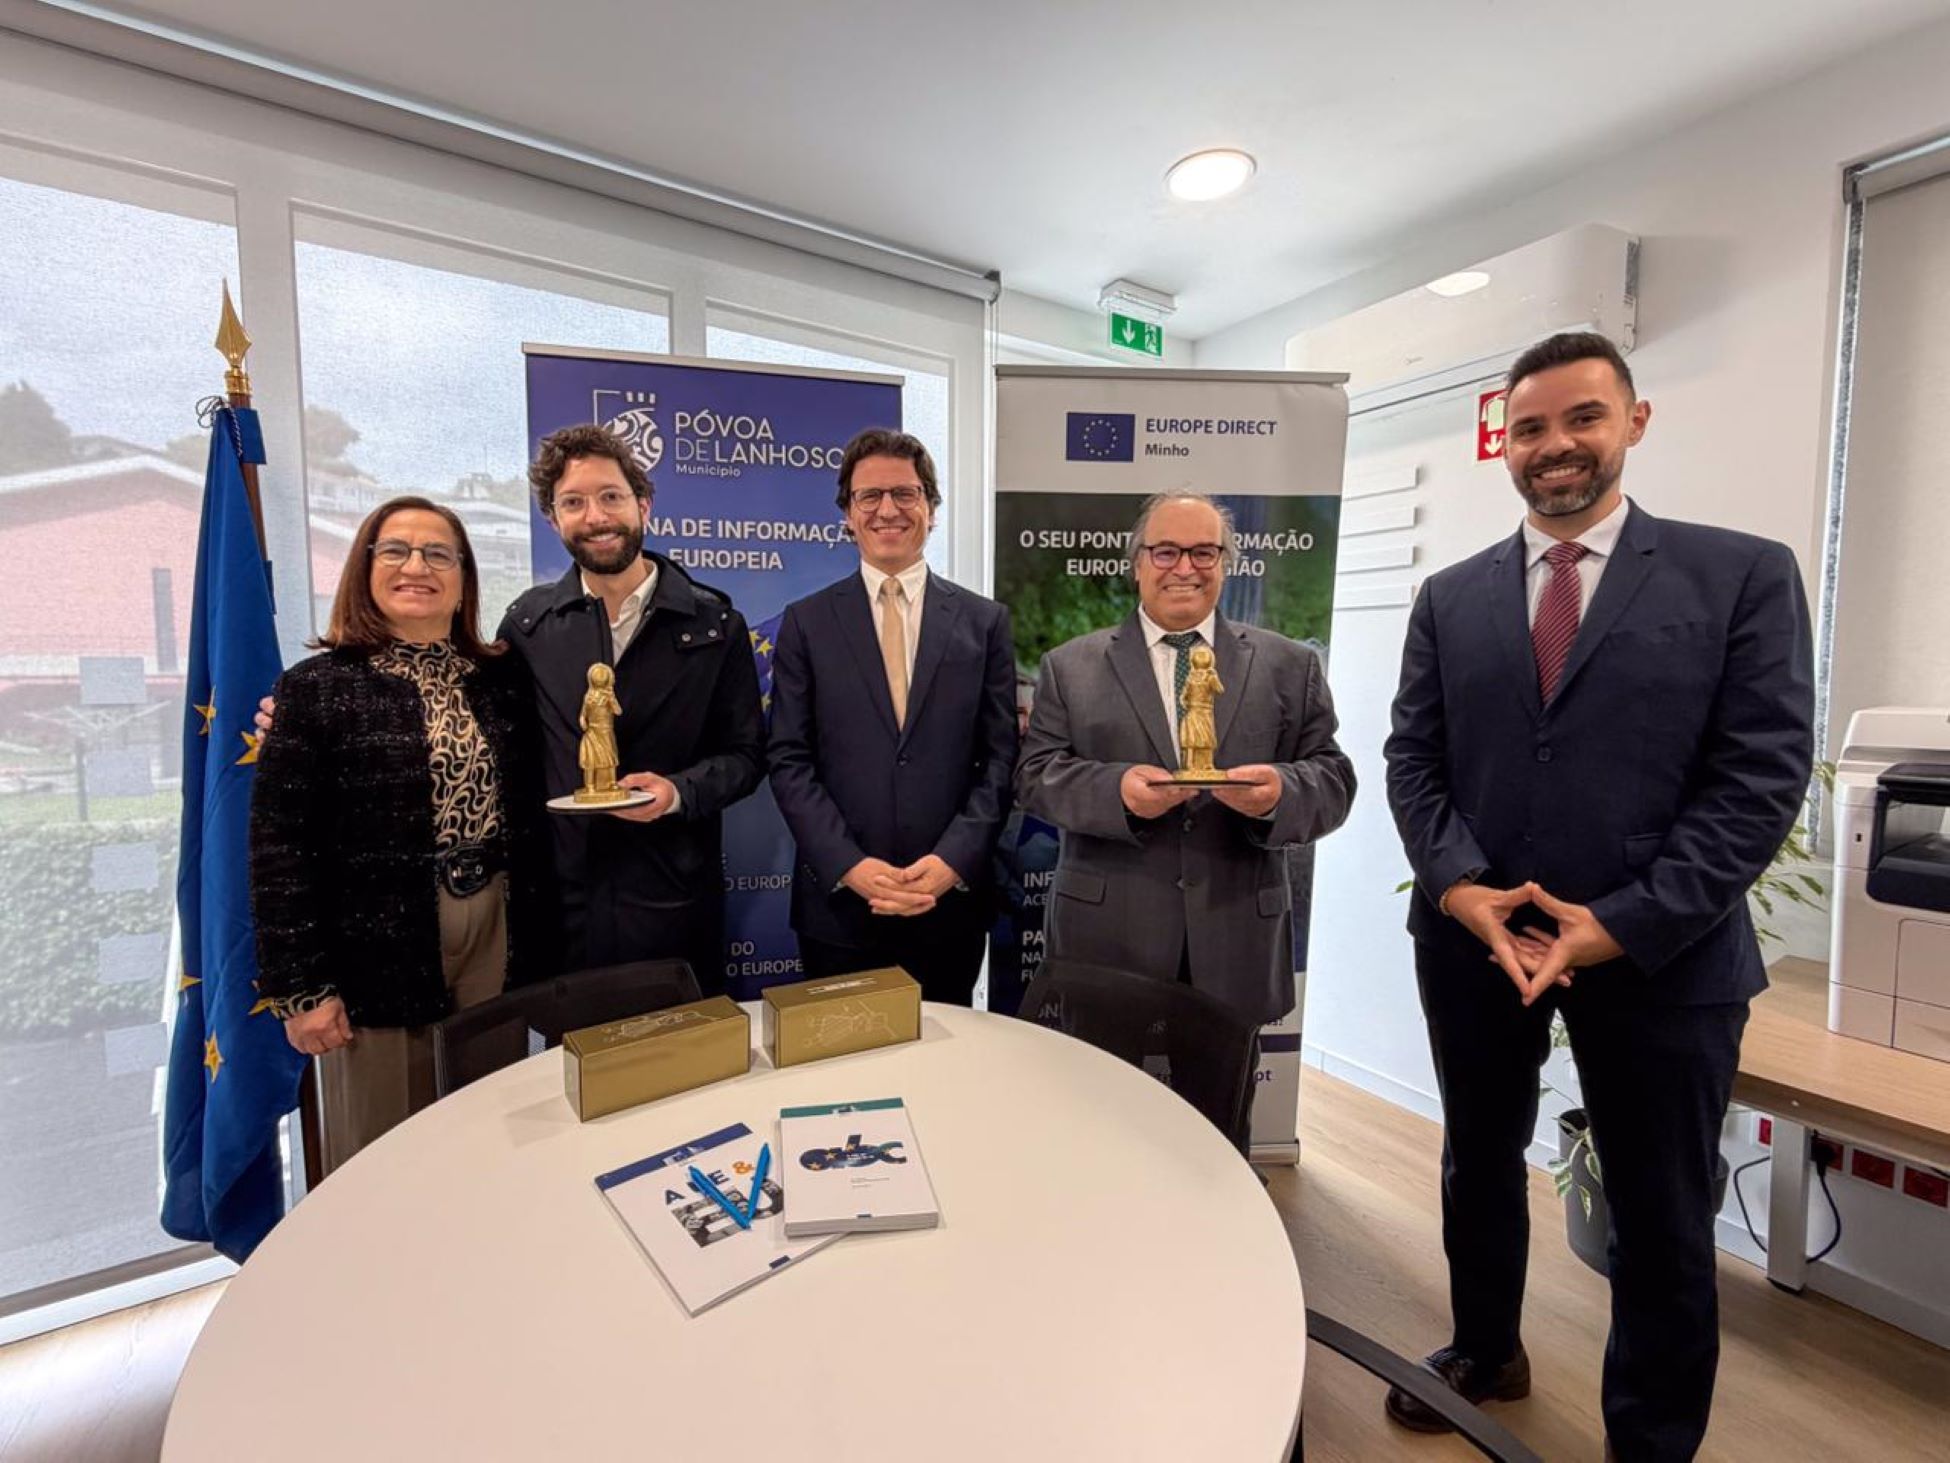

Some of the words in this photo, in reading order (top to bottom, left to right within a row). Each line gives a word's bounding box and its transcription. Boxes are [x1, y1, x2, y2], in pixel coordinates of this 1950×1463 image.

[675, 409, 774, 440] PÓVOA
[1145, 418, 1213, 434] EUROPE
[1217, 420, 1278, 435] DIRECT
[1144, 443, 1190, 457] Minho
[643, 516, 677, 537] NA
[681, 518, 712, 538] DE
[717, 519, 855, 549] INFORMAÇÃ
[1019, 530, 1035, 548] O
[1038, 530, 1075, 549] SEU
[1080, 531, 1134, 549] PONT
[1230, 529, 1314, 557] RMAÇÃO
[668, 547, 783, 570] EUROPEIA
[1066, 558, 1131, 577] EUROP
[737, 874, 792, 890] EUROP
[742, 958, 804, 976] EUROPE
